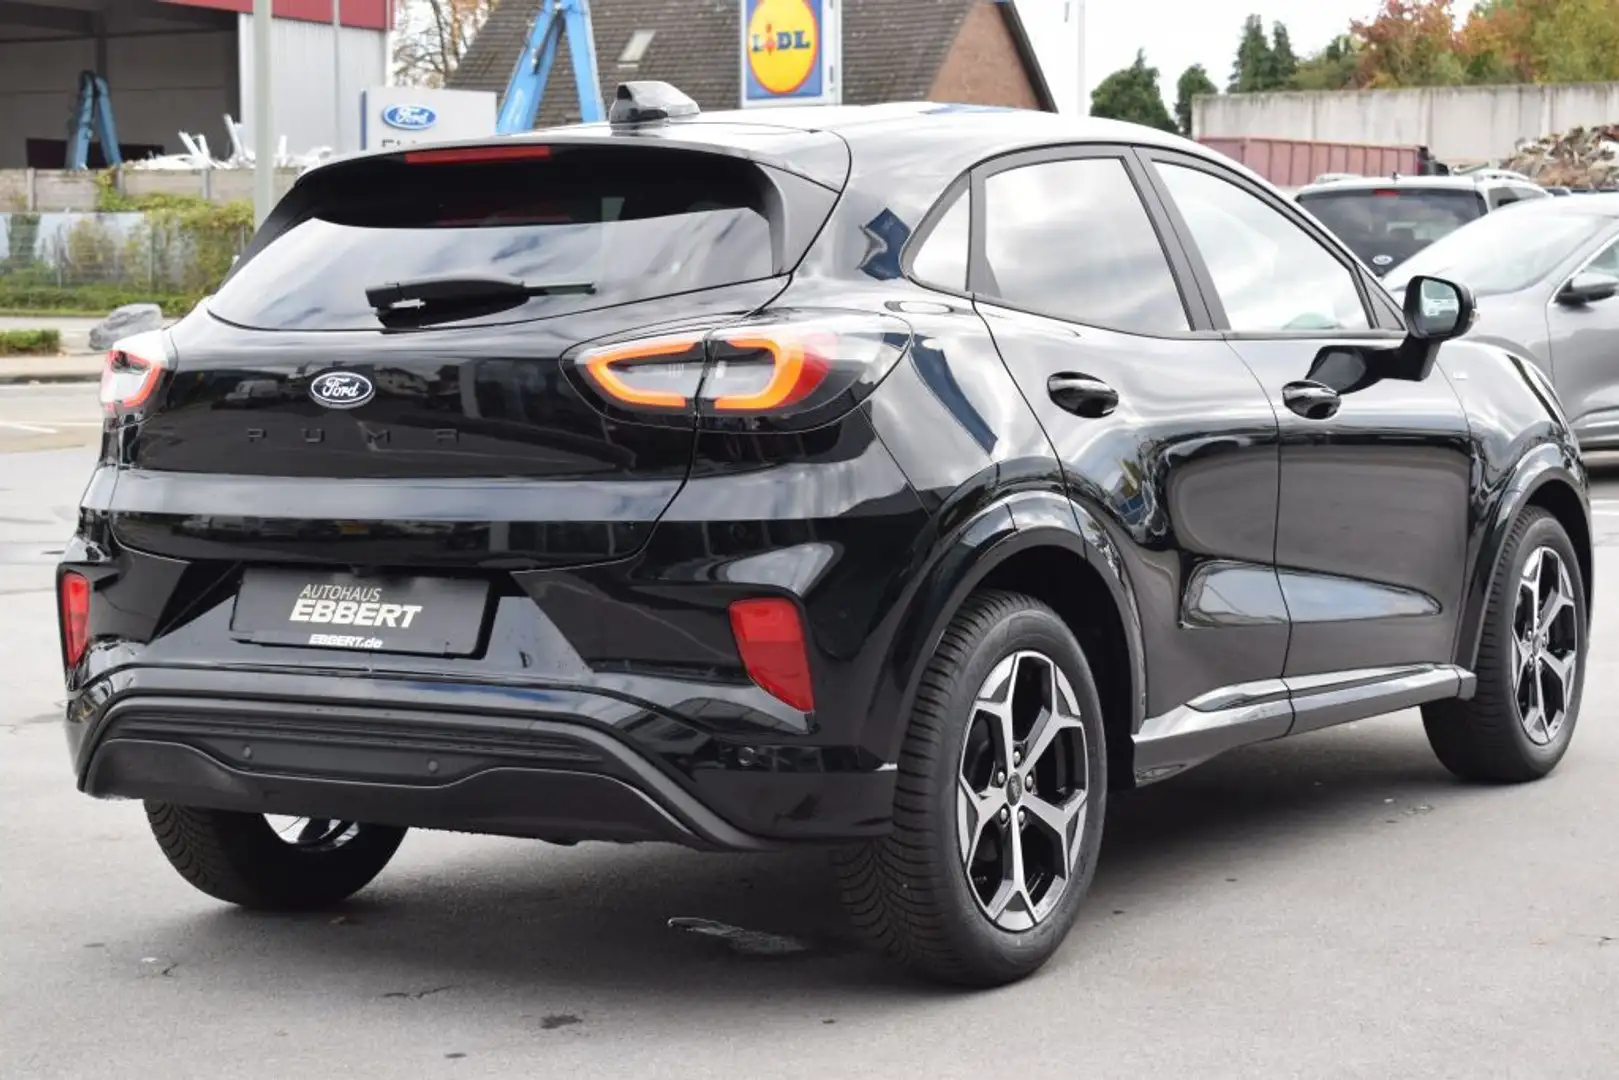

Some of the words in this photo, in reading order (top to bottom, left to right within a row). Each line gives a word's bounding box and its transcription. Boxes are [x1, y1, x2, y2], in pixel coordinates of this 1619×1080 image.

[395, 107, 430, 125] Ford
[321, 376, 361, 398] Ford
[247, 428, 460, 445] PUMA
[299, 583, 383, 602] AUTOHAUS
[288, 599, 424, 629] EBBERT
[308, 634, 385, 649] EBBERT.de
